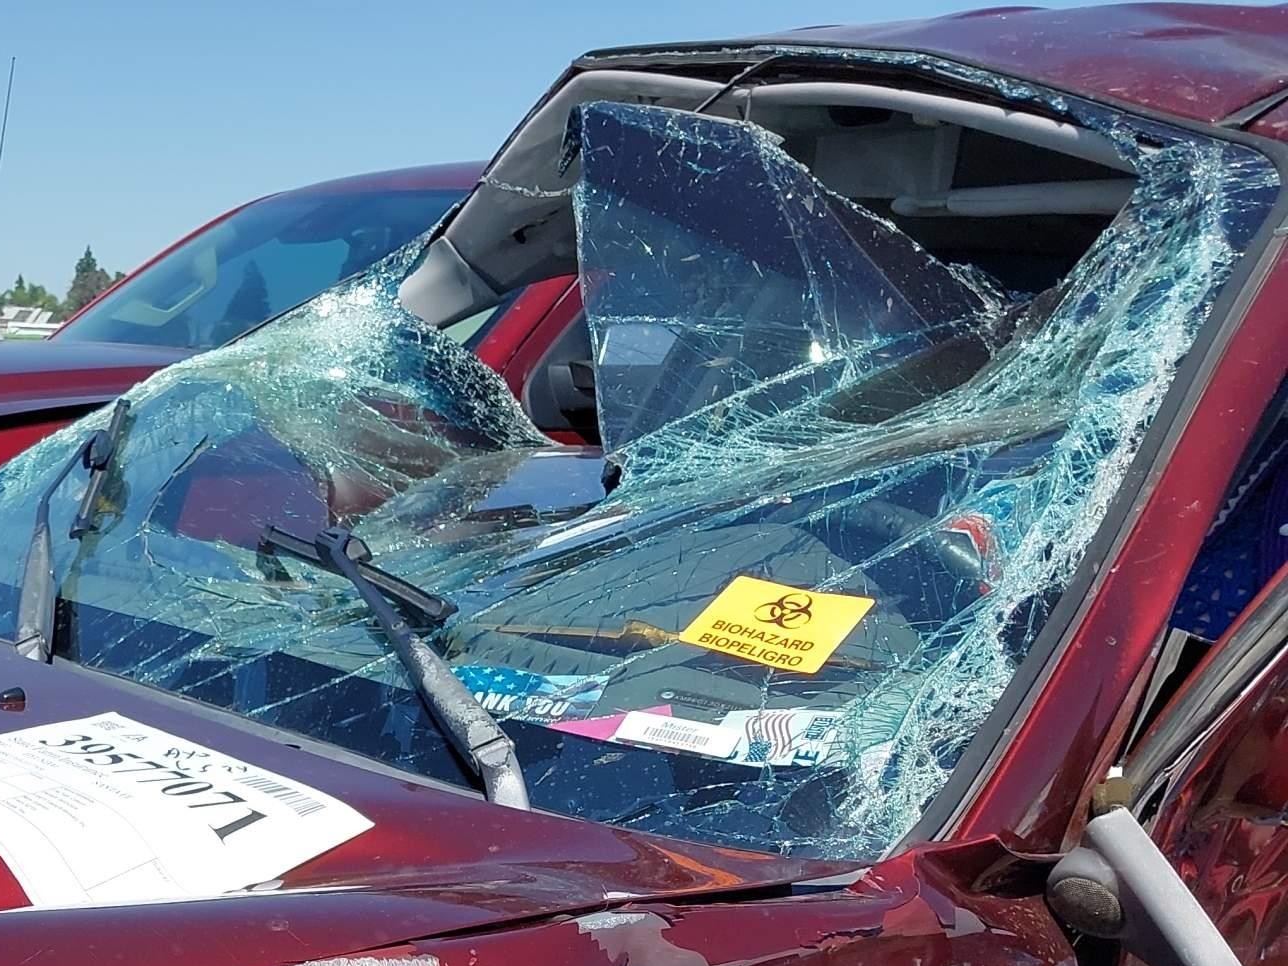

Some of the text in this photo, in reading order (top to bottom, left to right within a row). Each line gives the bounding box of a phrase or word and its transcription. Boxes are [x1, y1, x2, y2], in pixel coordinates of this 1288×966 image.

[698, 632, 803, 667] BIOPELIGRO
[711, 619, 815, 652] BIOHAZARD
[525, 695, 572, 716] YOU
[39, 734, 267, 845] 39577071
